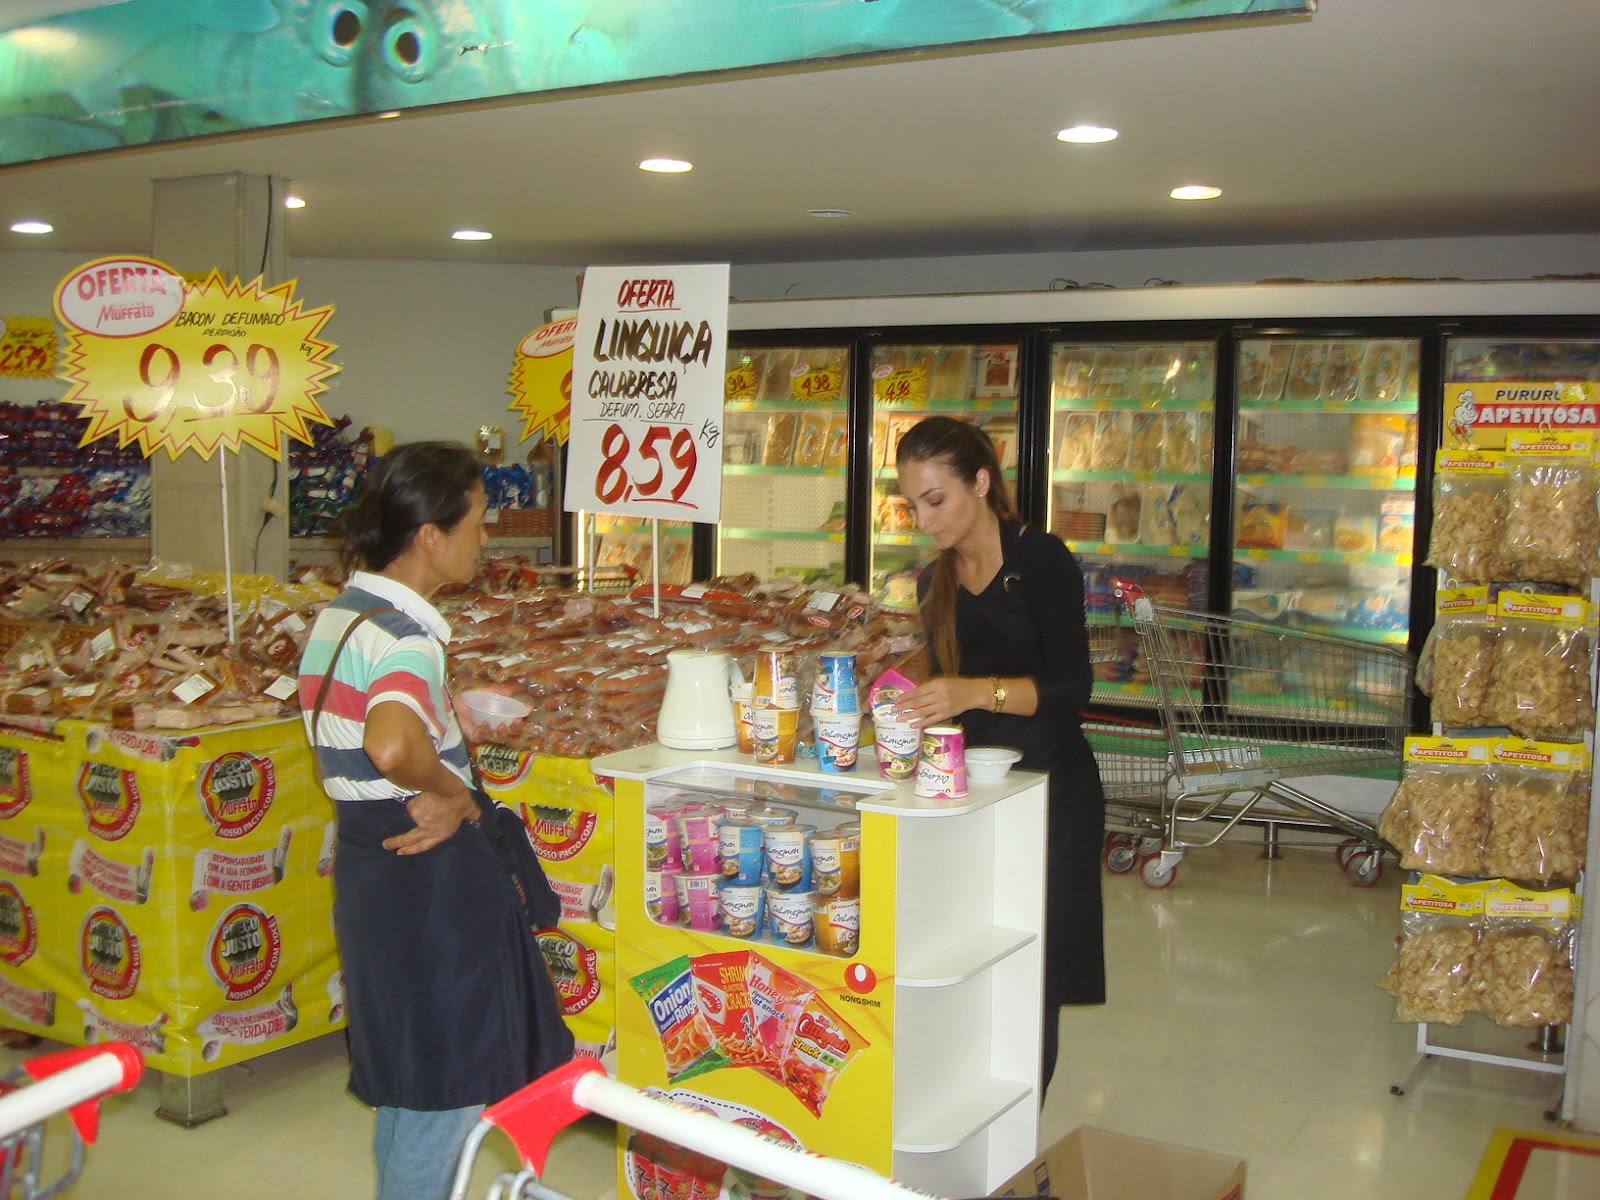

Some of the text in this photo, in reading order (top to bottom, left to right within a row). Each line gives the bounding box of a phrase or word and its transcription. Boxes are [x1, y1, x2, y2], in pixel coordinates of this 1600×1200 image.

[77, 267, 167, 301] OFERTA
[617, 278, 675, 308] OFERTA
[96, 301, 155, 328] Muffato
[175, 311, 286, 328] BACON DEFUMADO
[535, 320, 578, 341] OFER
[587, 369, 678, 400] CALABRESA
[646, 402, 686, 421] SEARA
[1477, 406, 1597, 425] APETITOSA
[1511, 605, 1559, 614] APETITOSA
[1416, 750, 1465, 758] APETITOSA
[1502, 752, 1548, 761] APETITOSA
[243, 811, 264, 832] PACTO
[263, 788, 274, 810] COM
[558, 841, 582, 859] PACTO
[580, 821, 594, 842] COM
[207, 874, 220, 889] COM
[220, 878, 226, 890] A
[226, 877, 251, 892] GENTE
[1413, 899, 1453, 908] APETITOSA
[220, 931, 262, 957] JUSTO
[535, 936, 577, 957] REÇO
[228, 990, 252, 1000] NOSSO
[252, 970, 272, 994] PACTO
[269, 947, 280, 969] COM
[564, 998, 588, 1014] PACTO
[587, 980, 600, 999] COM
[749, 973, 786, 1005] Honey
[653, 982, 691, 1022] Onion
[761, 1002, 786, 1021] snack
[839, 994, 881, 1008] NONGSHIM
